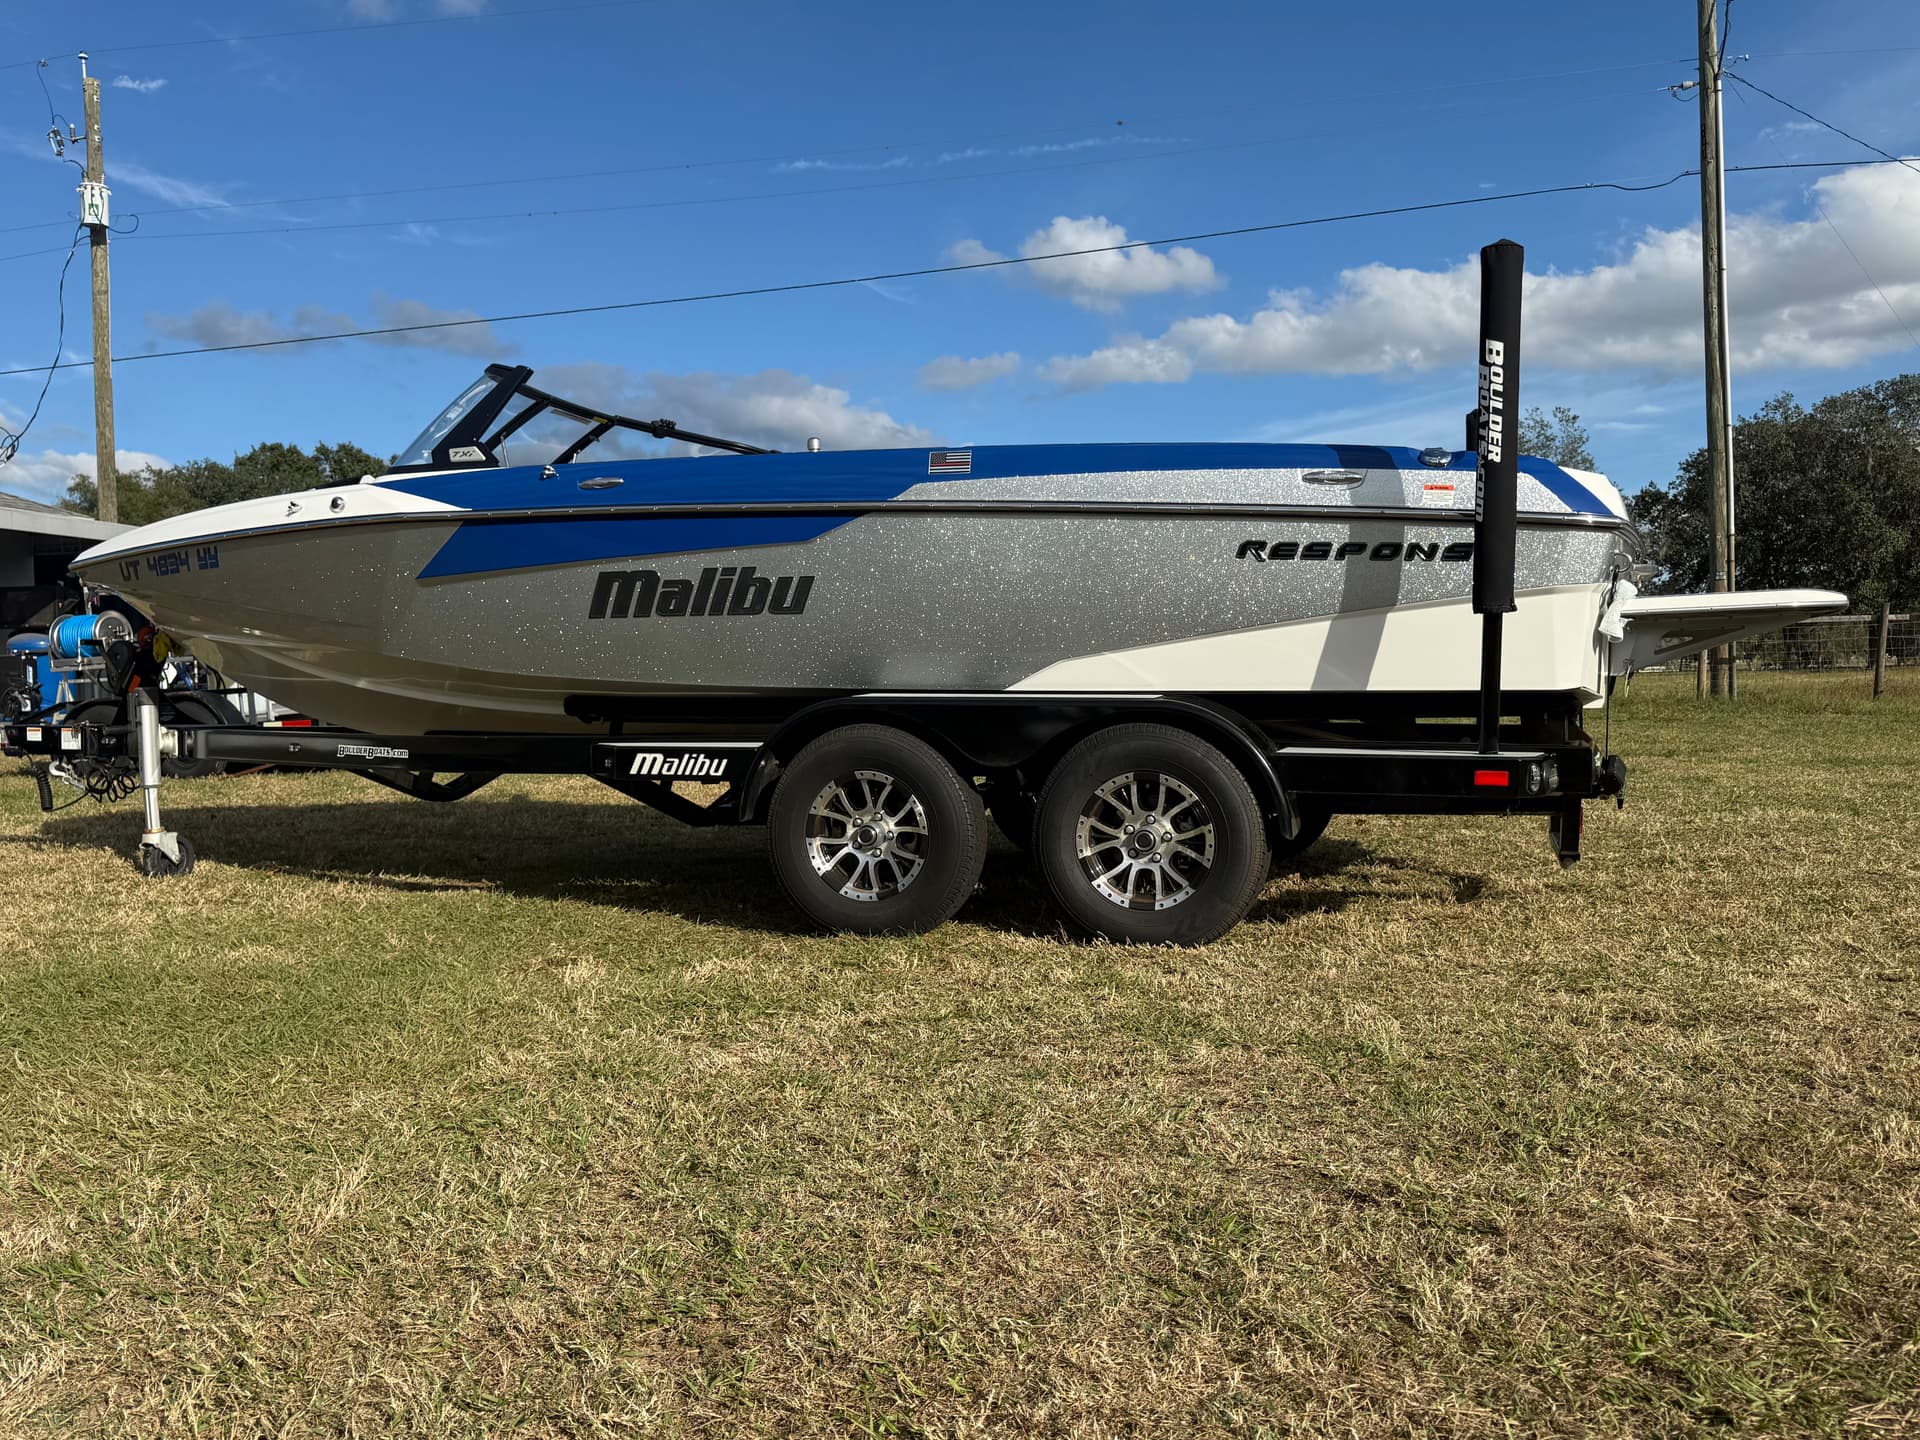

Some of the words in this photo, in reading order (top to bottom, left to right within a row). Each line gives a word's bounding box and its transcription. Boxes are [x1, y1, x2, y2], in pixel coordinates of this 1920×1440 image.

[1485, 338, 1504, 463] BOULDER
[119, 559, 140, 581] UT
[146, 551, 191, 576] 4834
[1235, 540, 1475, 562] RESPONS
[589, 567, 815, 619] Malibu
[629, 753, 728, 776] Malibu
